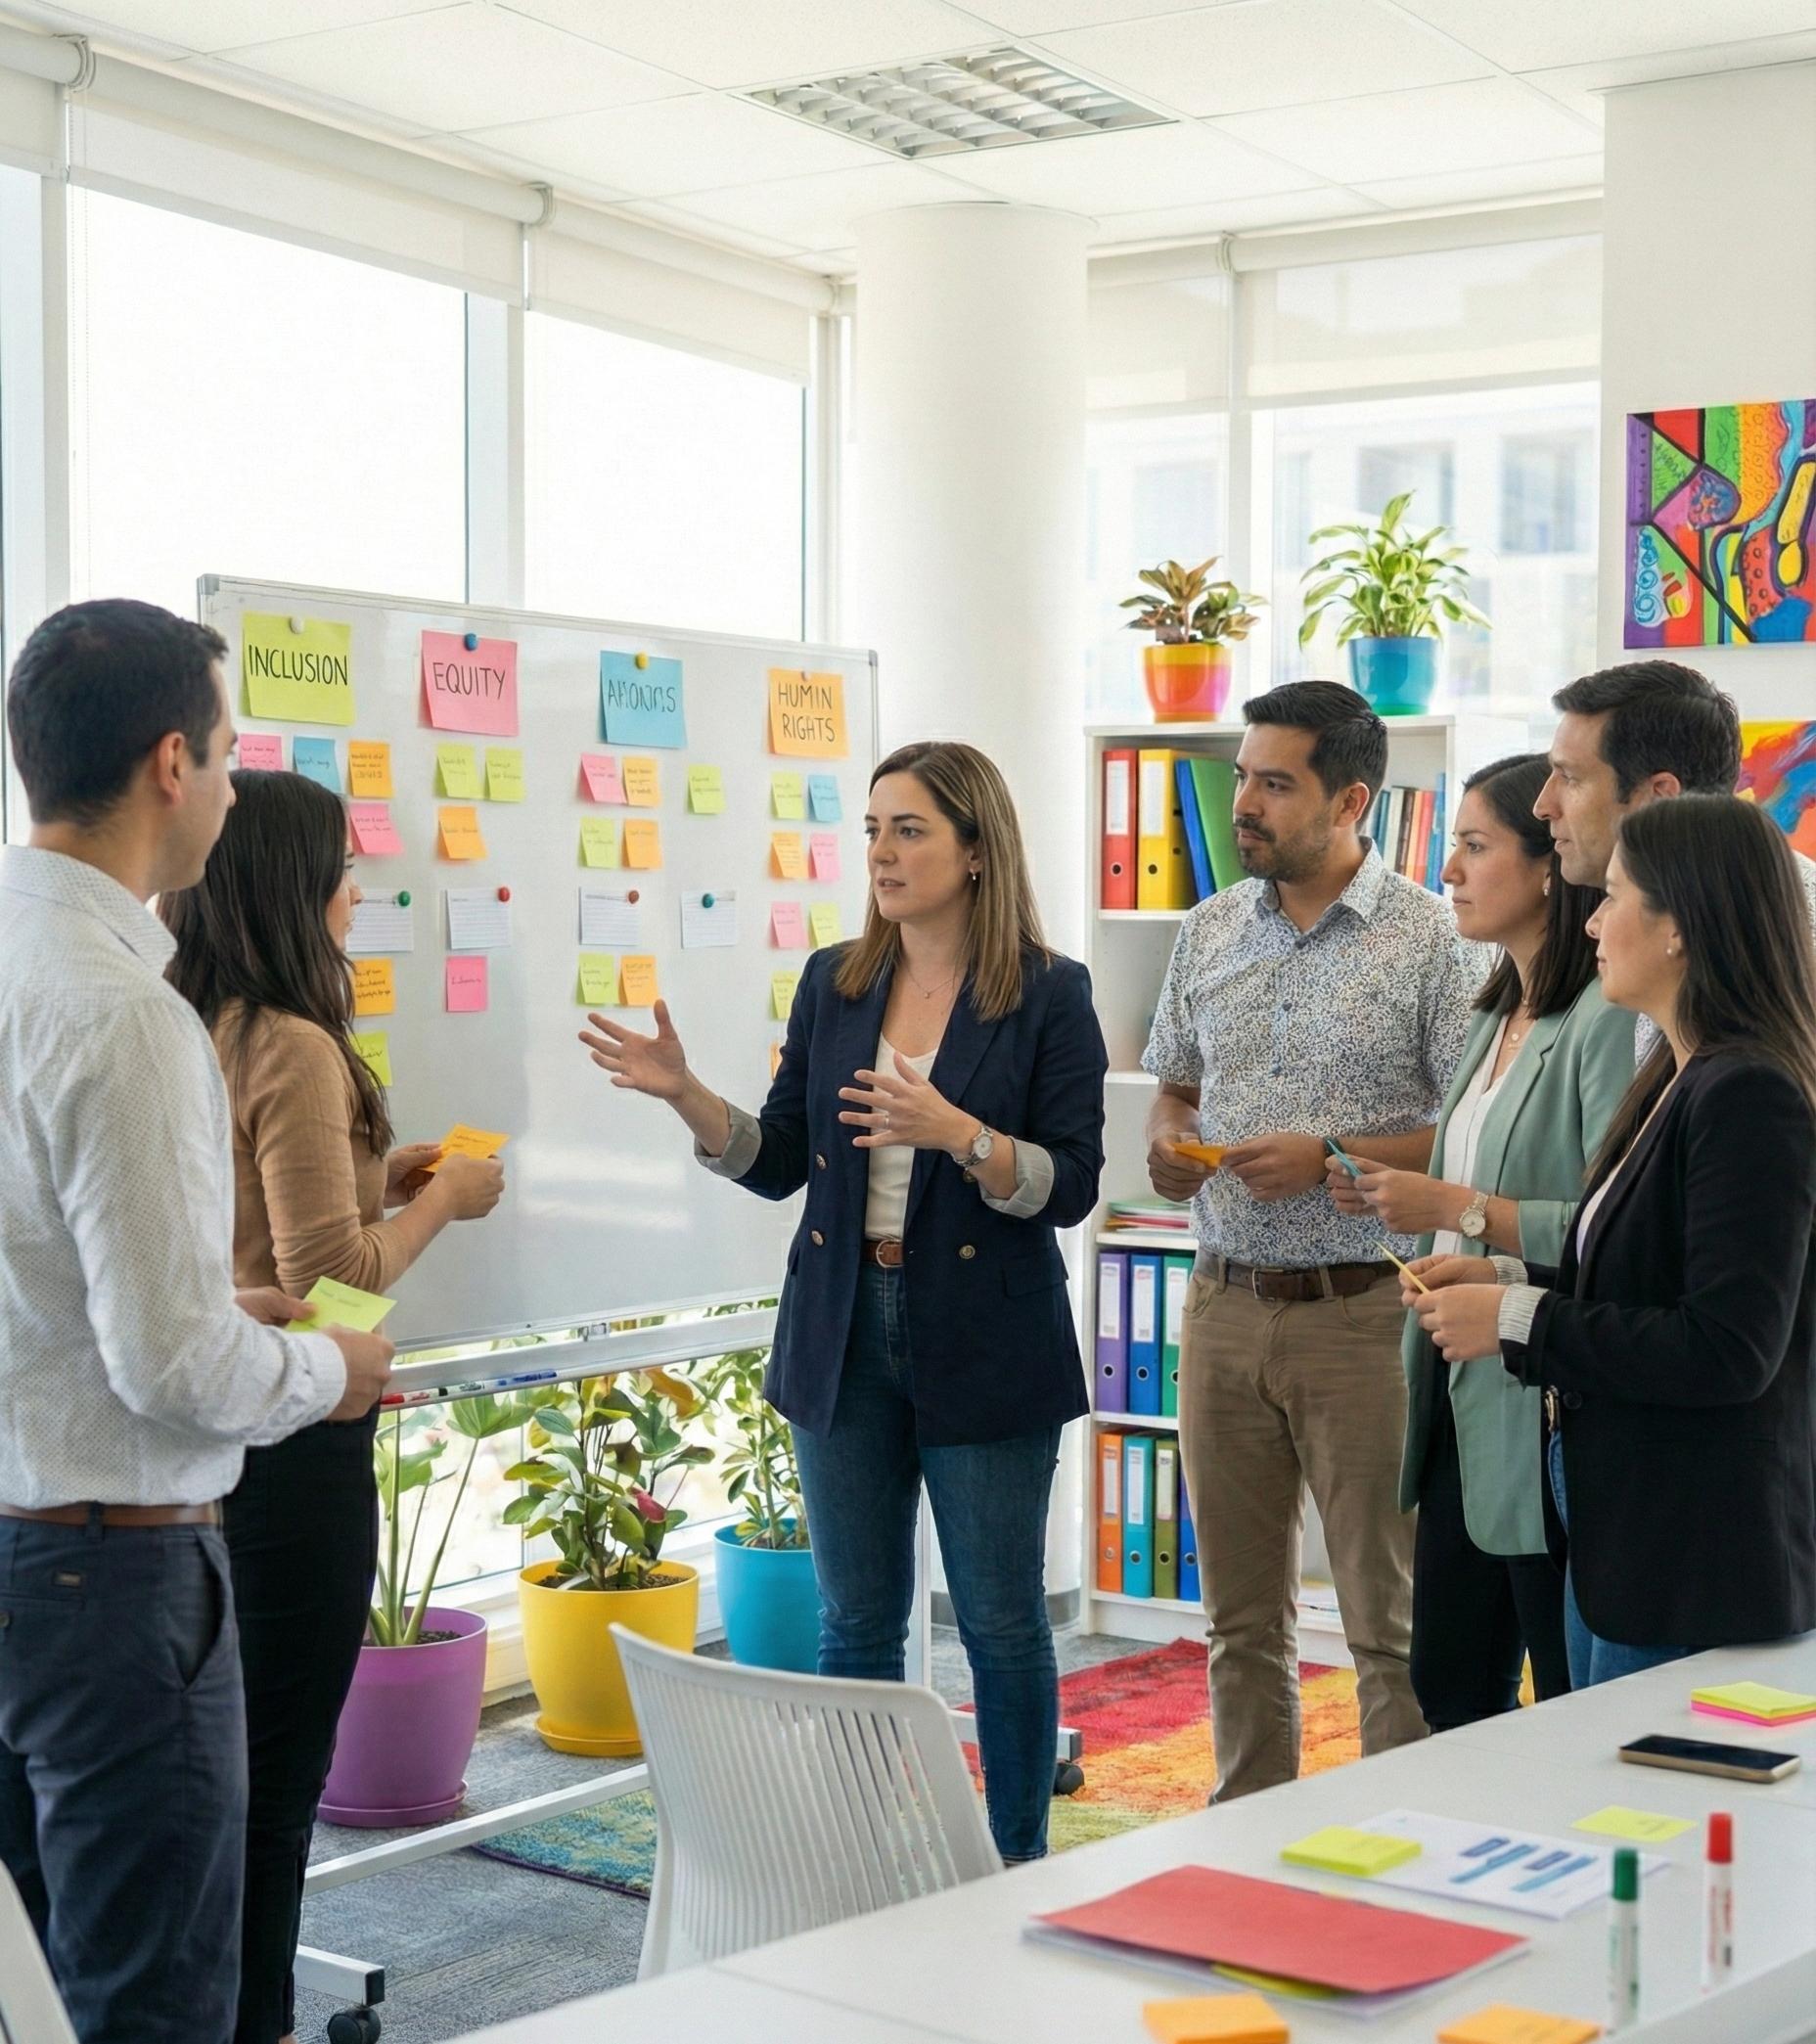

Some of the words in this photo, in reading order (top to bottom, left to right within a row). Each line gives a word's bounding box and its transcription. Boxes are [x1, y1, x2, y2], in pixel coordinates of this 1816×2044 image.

[249, 644, 348, 686] INCLUSION
[432, 661, 506, 700] EQUITY
[783, 713, 836, 743] RIGHTS
